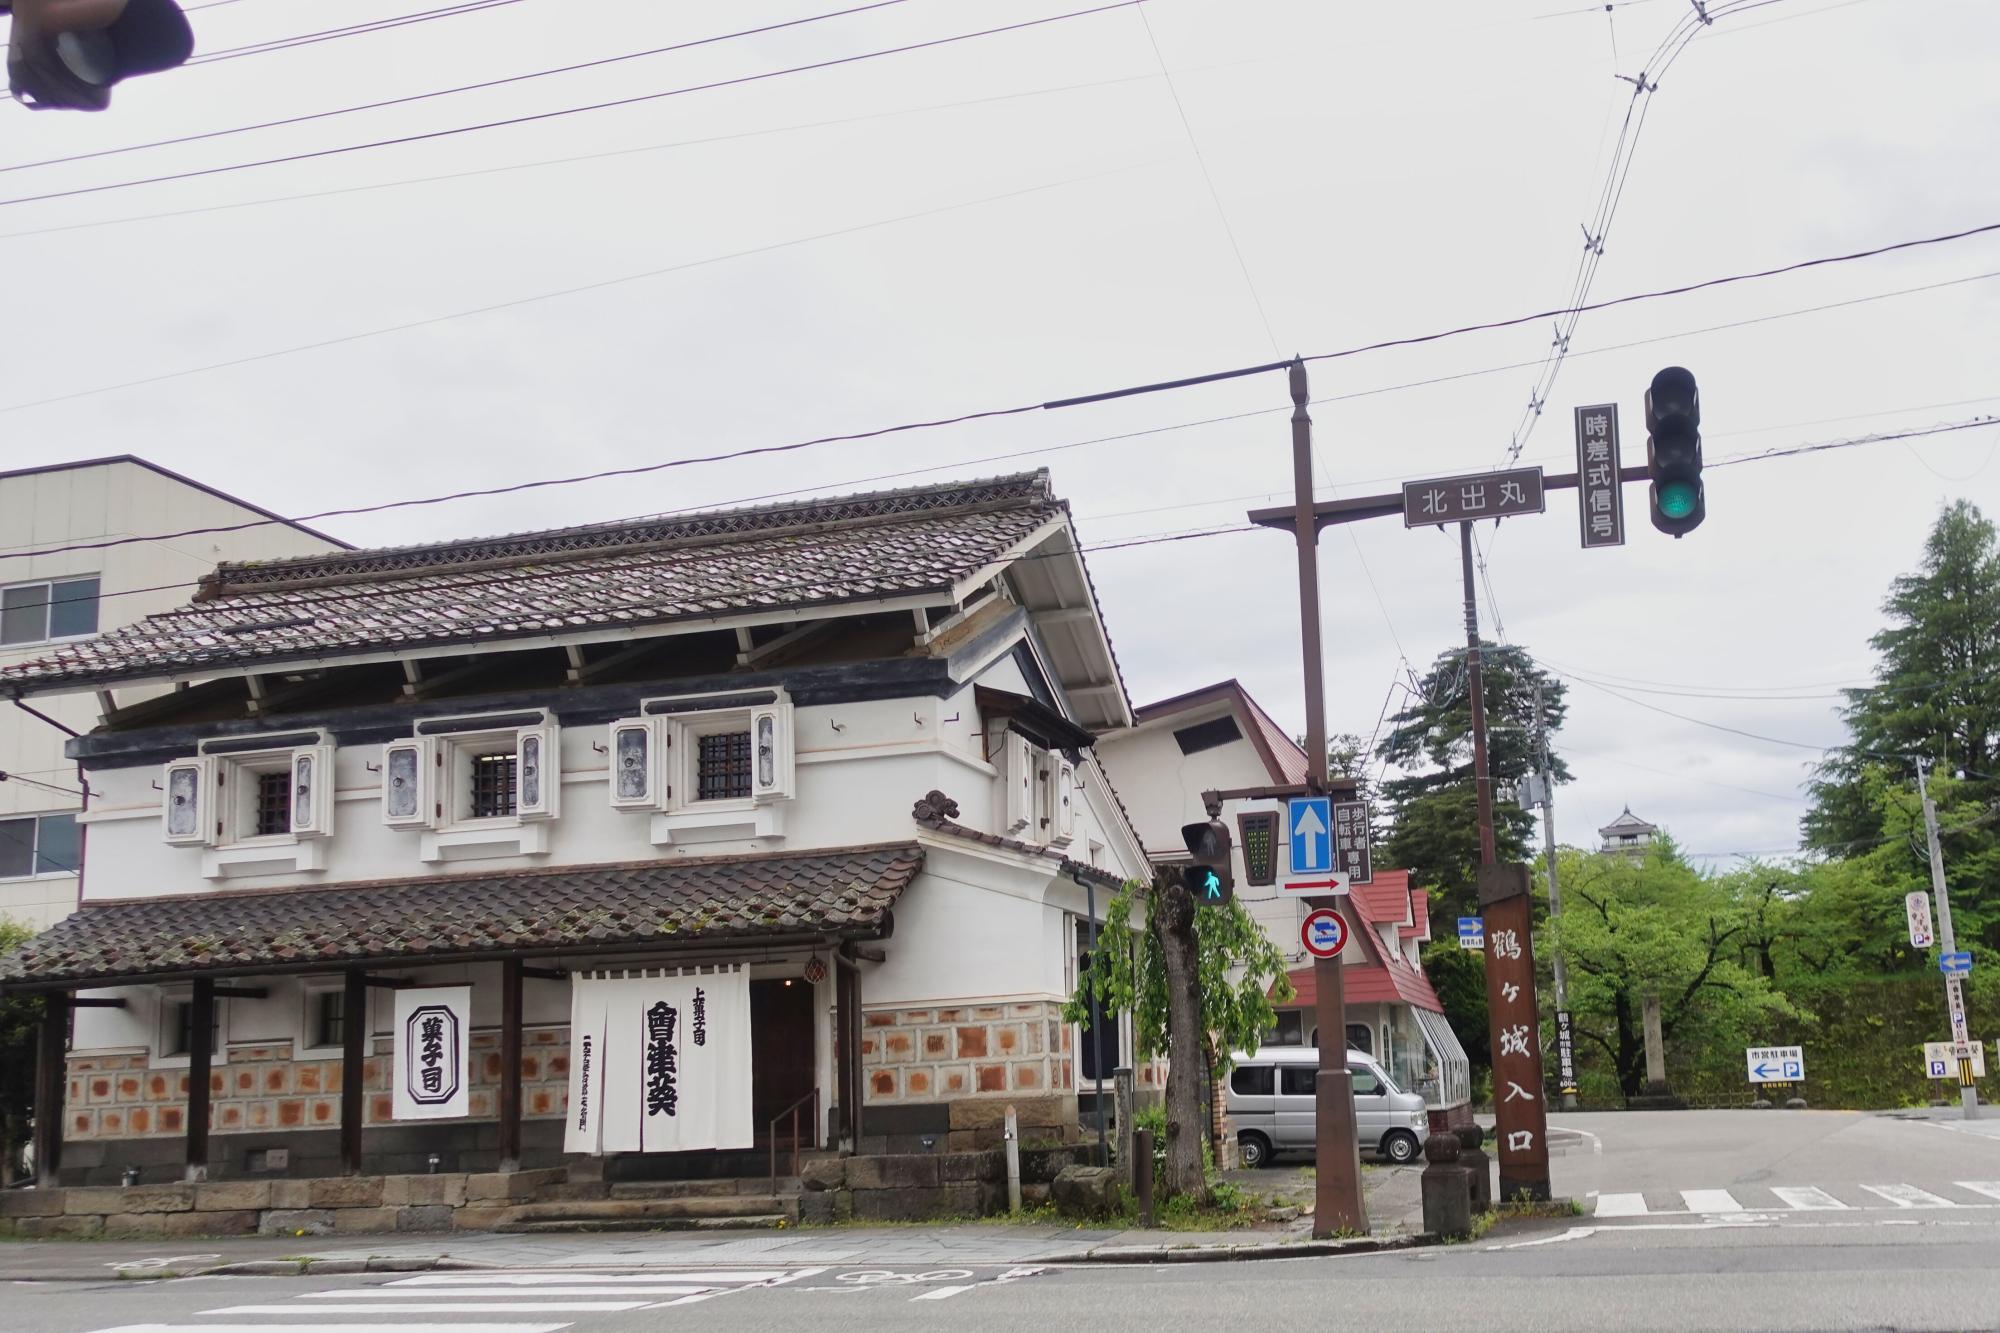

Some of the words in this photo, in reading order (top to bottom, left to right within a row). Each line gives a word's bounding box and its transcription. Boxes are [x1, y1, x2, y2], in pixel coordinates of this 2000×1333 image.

[1585, 415, 1613, 537] 時差式信号
[1421, 480, 1526, 515] 北出丸
[1338, 809, 1351, 850] 自転車
[1352, 808, 1366, 850] 歩行者
[1347, 851, 1361, 879] 専用
[693, 986, 706, 1047] 上菓子司
[421, 1016, 444, 1094] 菓子司
[1785, 1063, 1798, 1077] P
